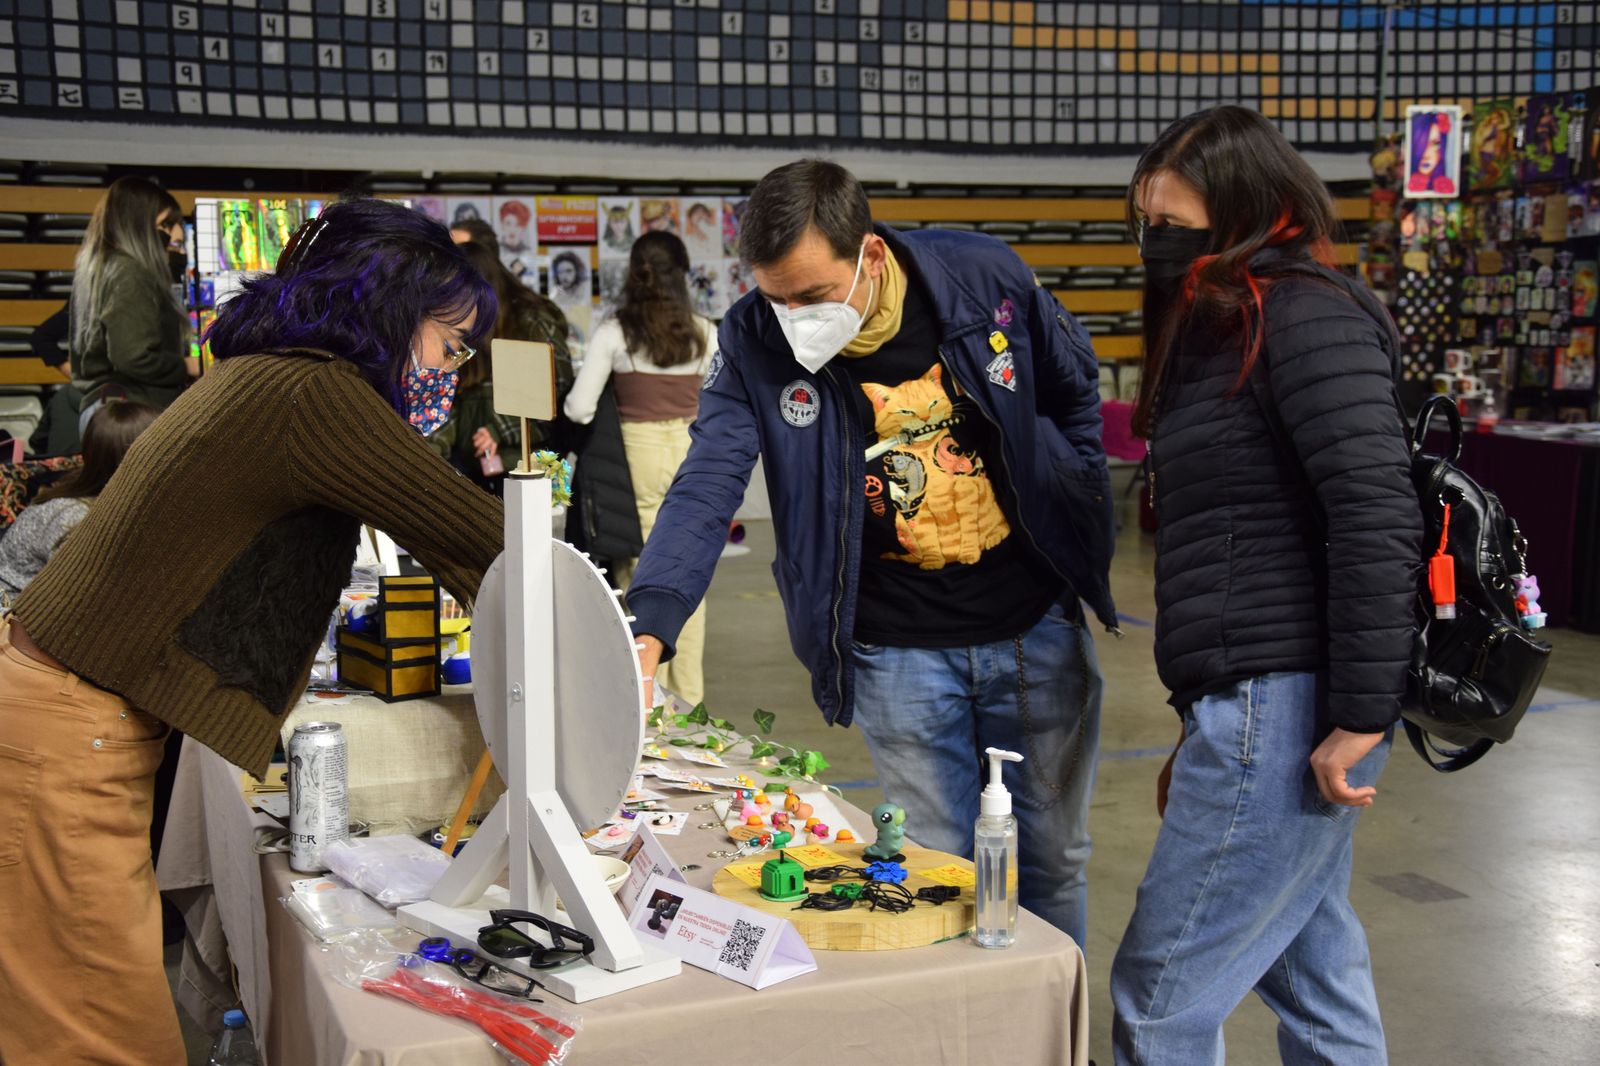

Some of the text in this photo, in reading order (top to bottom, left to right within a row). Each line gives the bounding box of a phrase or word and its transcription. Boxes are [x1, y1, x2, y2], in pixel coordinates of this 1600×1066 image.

[178, 11, 190, 26] 5
[581, 10, 592, 23] 2
[728, 16, 737, 30] 1
[266, 17, 276, 33] 4
[211, 41, 221, 57] 1
[324, 49, 334, 64] 1
[378, 52, 387, 66] 1
[483, 56, 492, 70] 1
[181, 66, 192, 82] 9
[677, 925, 697, 942] Etsy
